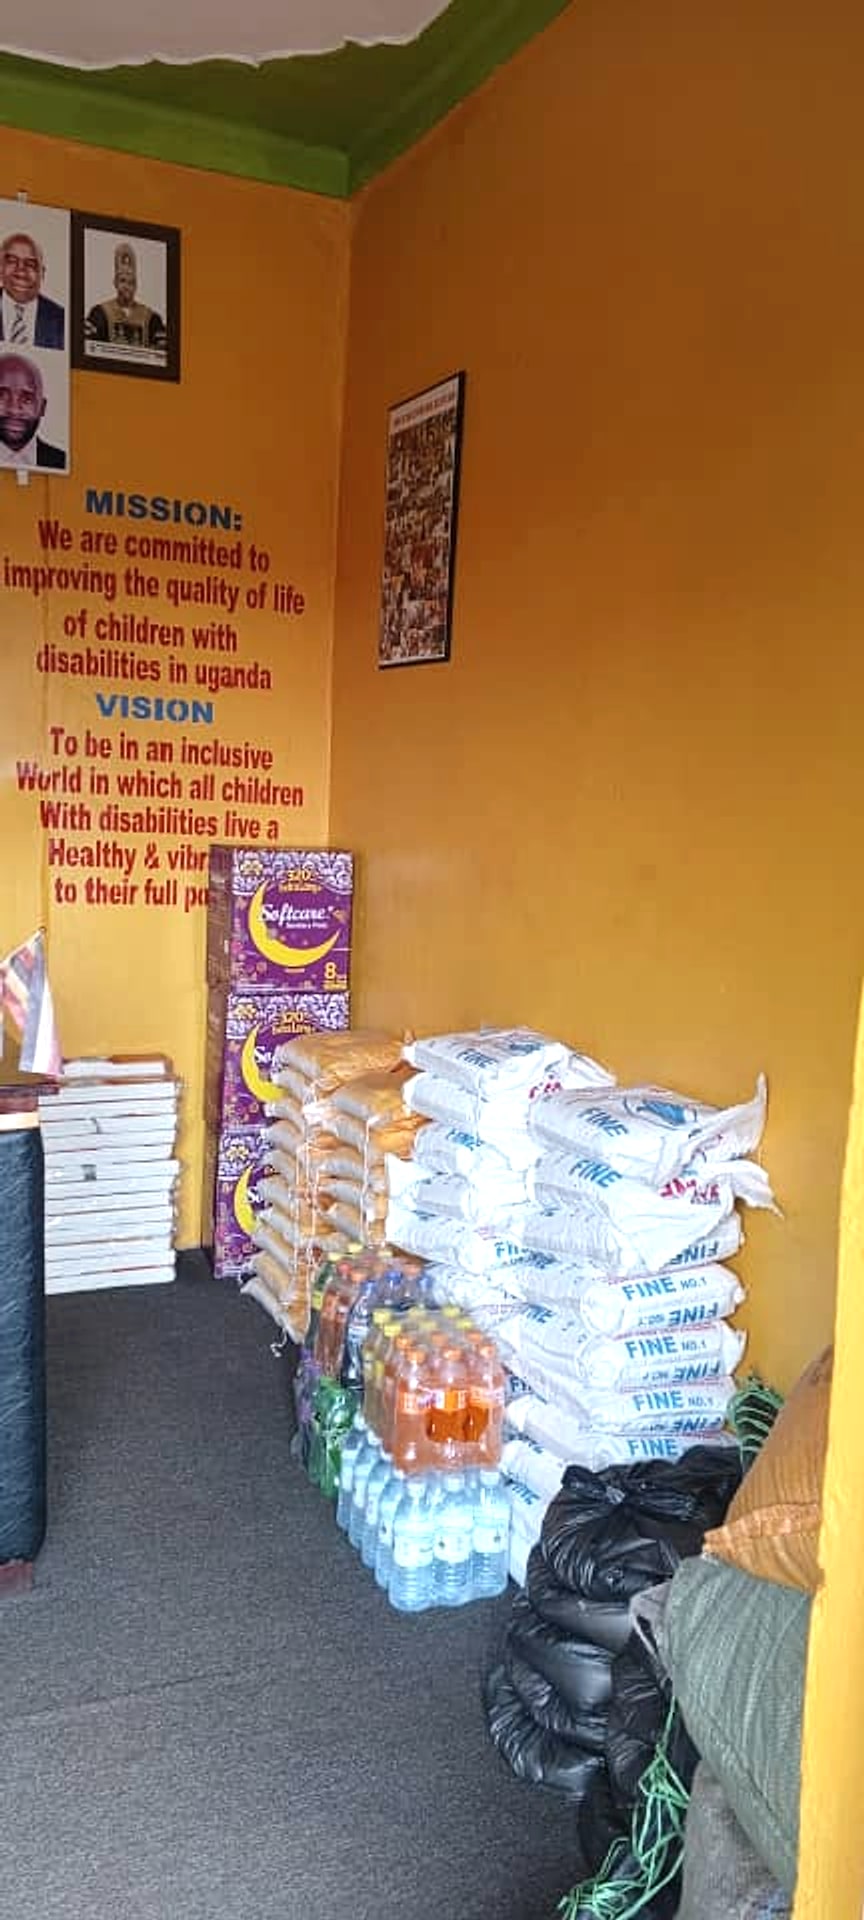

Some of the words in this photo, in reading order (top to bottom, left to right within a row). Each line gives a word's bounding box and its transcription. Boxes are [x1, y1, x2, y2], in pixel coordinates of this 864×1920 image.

[86, 488, 242, 531] MISSION:
[38, 520, 73, 550] We
[80, 528, 117, 555] are
[124, 533, 241, 569] committed
[249, 545, 270, 573] to
[3, 557, 117, 601] improving
[124, 567, 159, 597] the
[167, 576, 239, 613] quality
[246, 582, 267, 609] of
[274, 584, 305, 615] life
[64, 609, 87, 638] of
[95, 612, 184, 646] children
[192, 622, 237, 652] with
[36, 644, 161, 681] disabilities
[169, 655, 187, 683] in
[195, 662, 272, 693] uganda
[96, 693, 214, 724] VISION
[50, 727, 77, 756] To
[85, 730, 111, 759] be
[120, 732, 138, 761] in
[146, 742, 173, 763] an
[181, 736, 273, 770] inclusive
[16, 762, 81, 793] World
[90, 767, 109, 795] in
[117, 769, 182, 800] which
[189, 775, 214, 801] all
[222, 776, 303, 806] children
[40, 801, 91, 831] With
[99, 805, 218, 837] disabilities
[224, 810, 260, 840] live
[266, 820, 279, 840] a
[48, 838, 136, 875] Healthy
[144, 842, 160, 870] &
[54, 878, 77, 904] to
[85, 878, 138, 906] their
[144, 879, 177, 905] full
[258, 902, 329, 926] Softcare
[324, 961, 337, 980] 8
[456, 1048, 499, 1068] FINE
[577, 1106, 629, 1137] FINE
[569, 1158, 623, 1188] FINE
[622, 1276, 677, 1301] FINE
[668, 1302, 719, 1327] FINE
[625, 1336, 678, 1358] FINE
[632, 1389, 685, 1411] FINE
[627, 1438, 679, 1456] FINE
